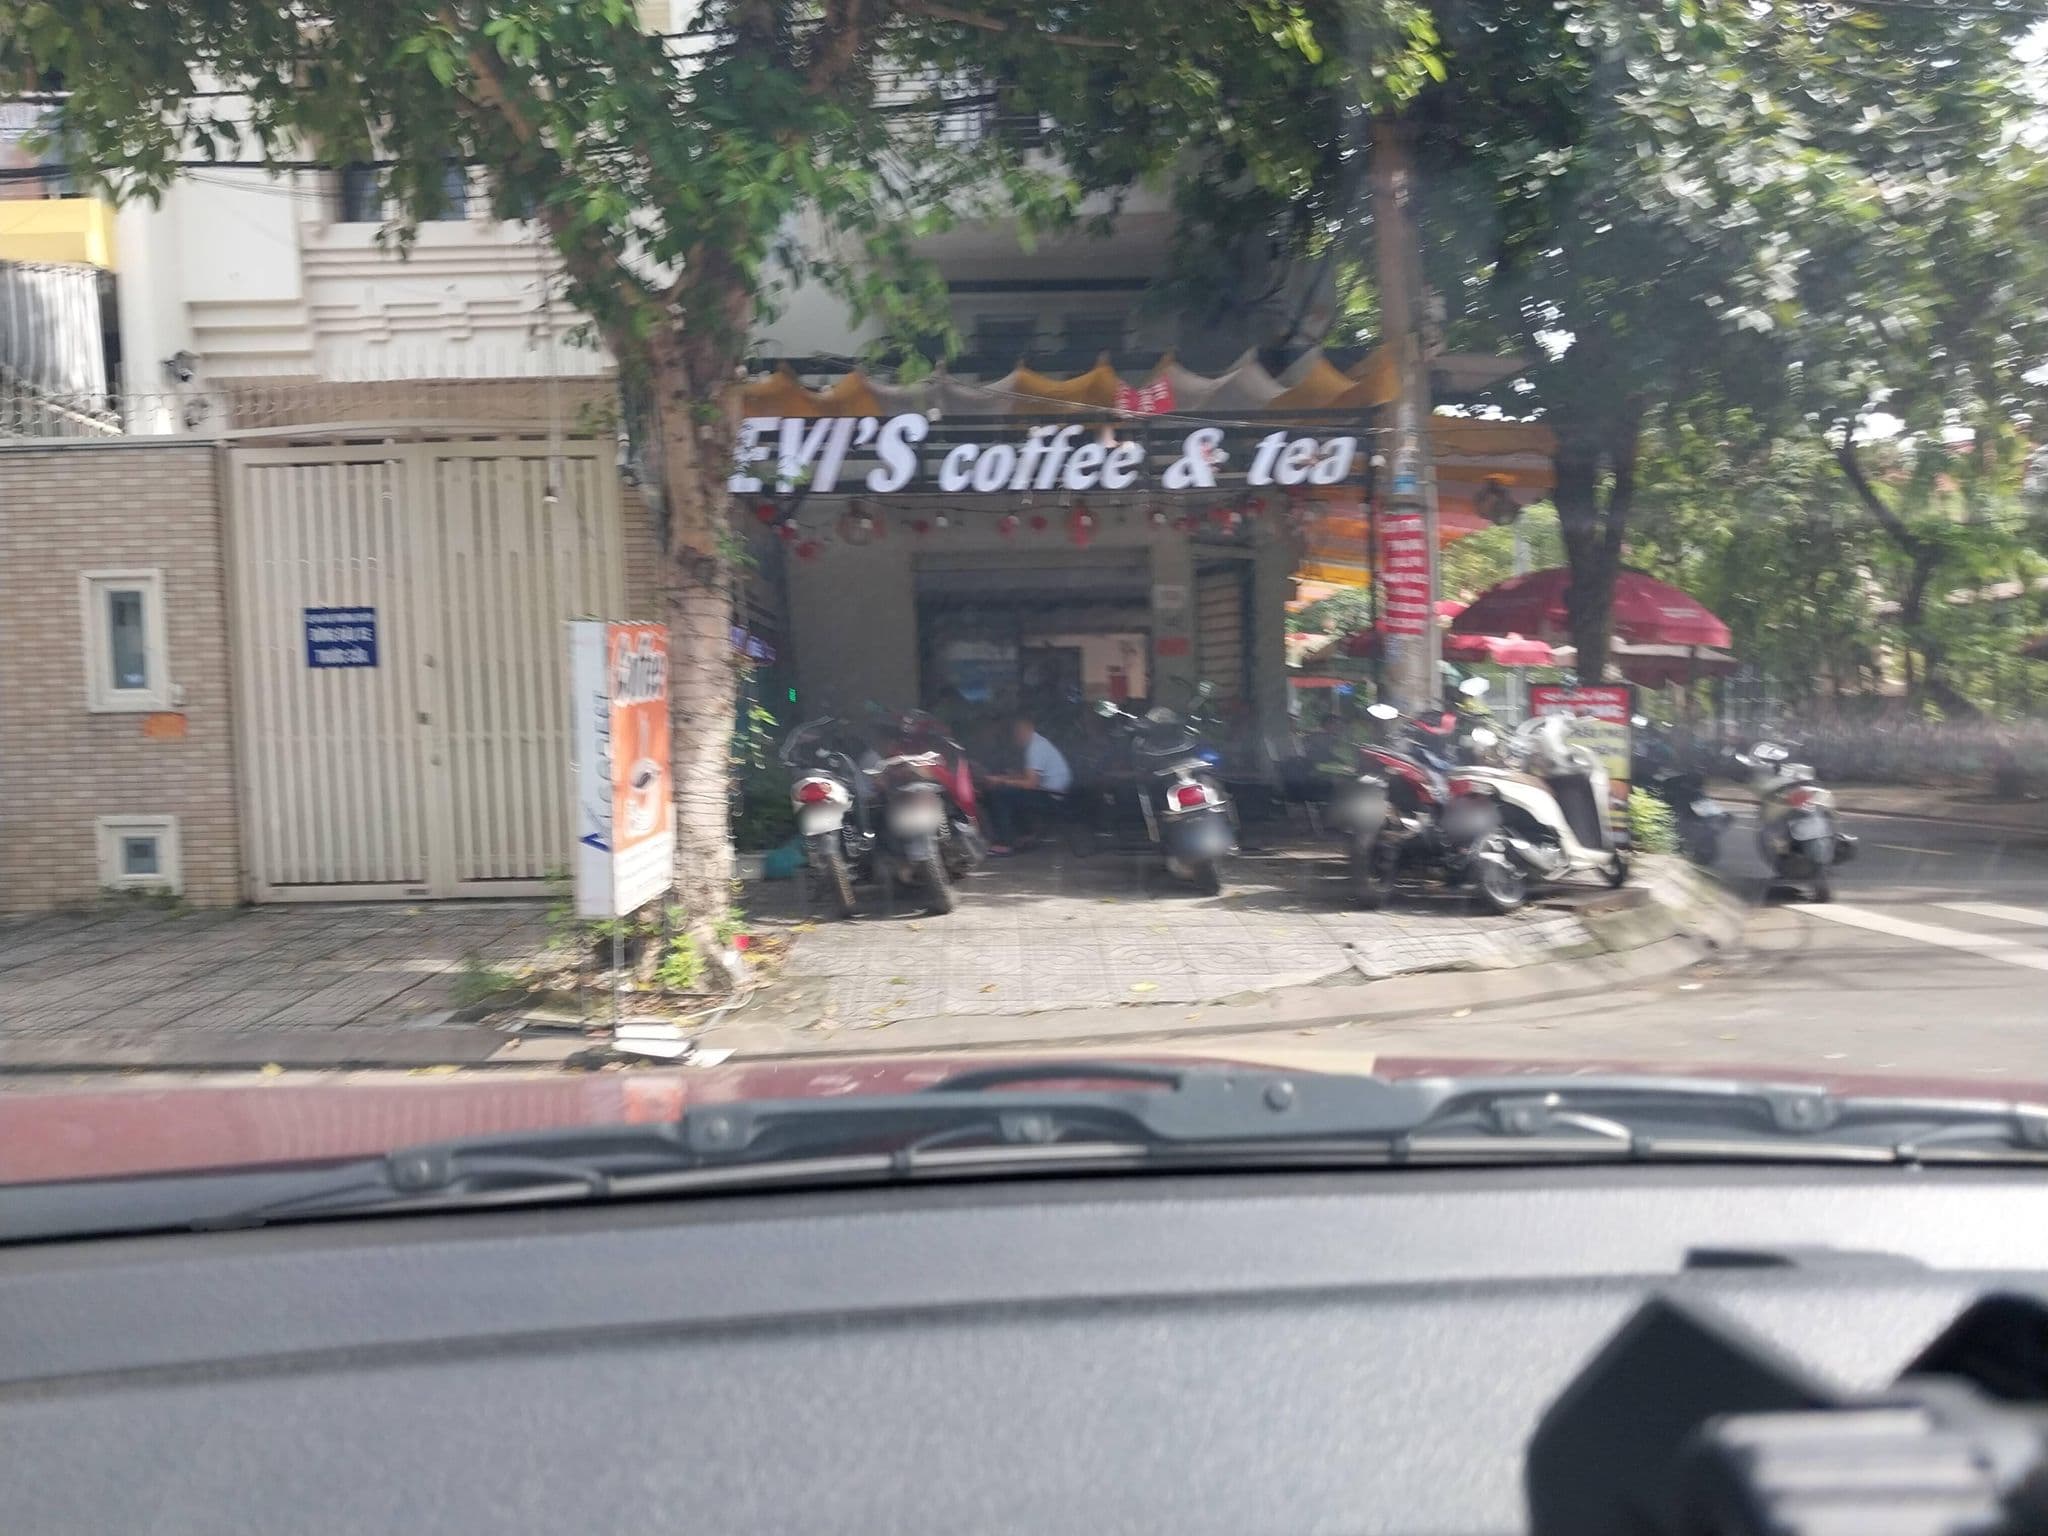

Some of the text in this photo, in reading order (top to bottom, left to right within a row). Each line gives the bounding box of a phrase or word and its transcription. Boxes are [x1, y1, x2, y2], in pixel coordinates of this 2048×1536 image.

[938, 424, 1147, 492] coffee
[1161, 427, 1226, 489] &
[1247, 430, 1358, 486] tea
